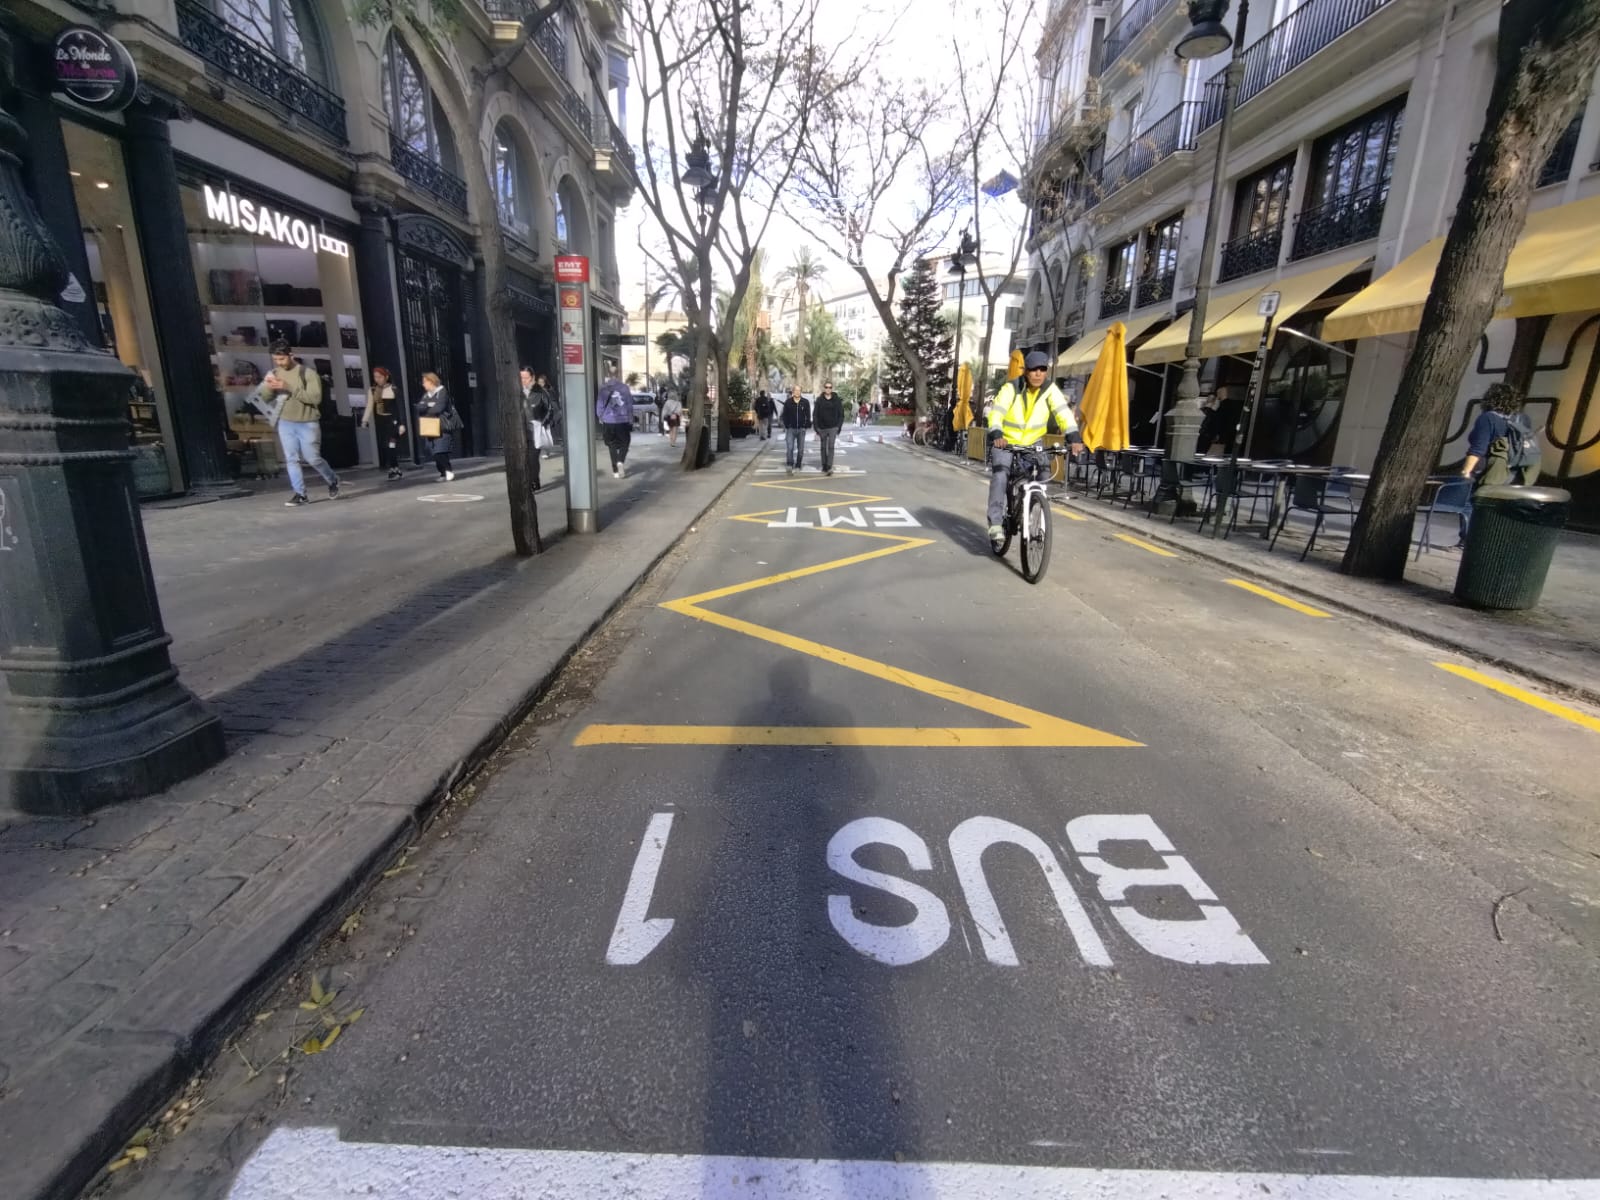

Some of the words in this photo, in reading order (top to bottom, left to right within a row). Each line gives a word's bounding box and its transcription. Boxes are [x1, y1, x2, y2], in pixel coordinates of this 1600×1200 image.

[56, 48, 69, 60] Le
[69, 45, 112, 61] Monde
[203, 184, 310, 249] MISAKO
[767, 506, 922, 527] EMT
[605, 812, 675, 966] 1
[826, 815, 1270, 967] BUS
